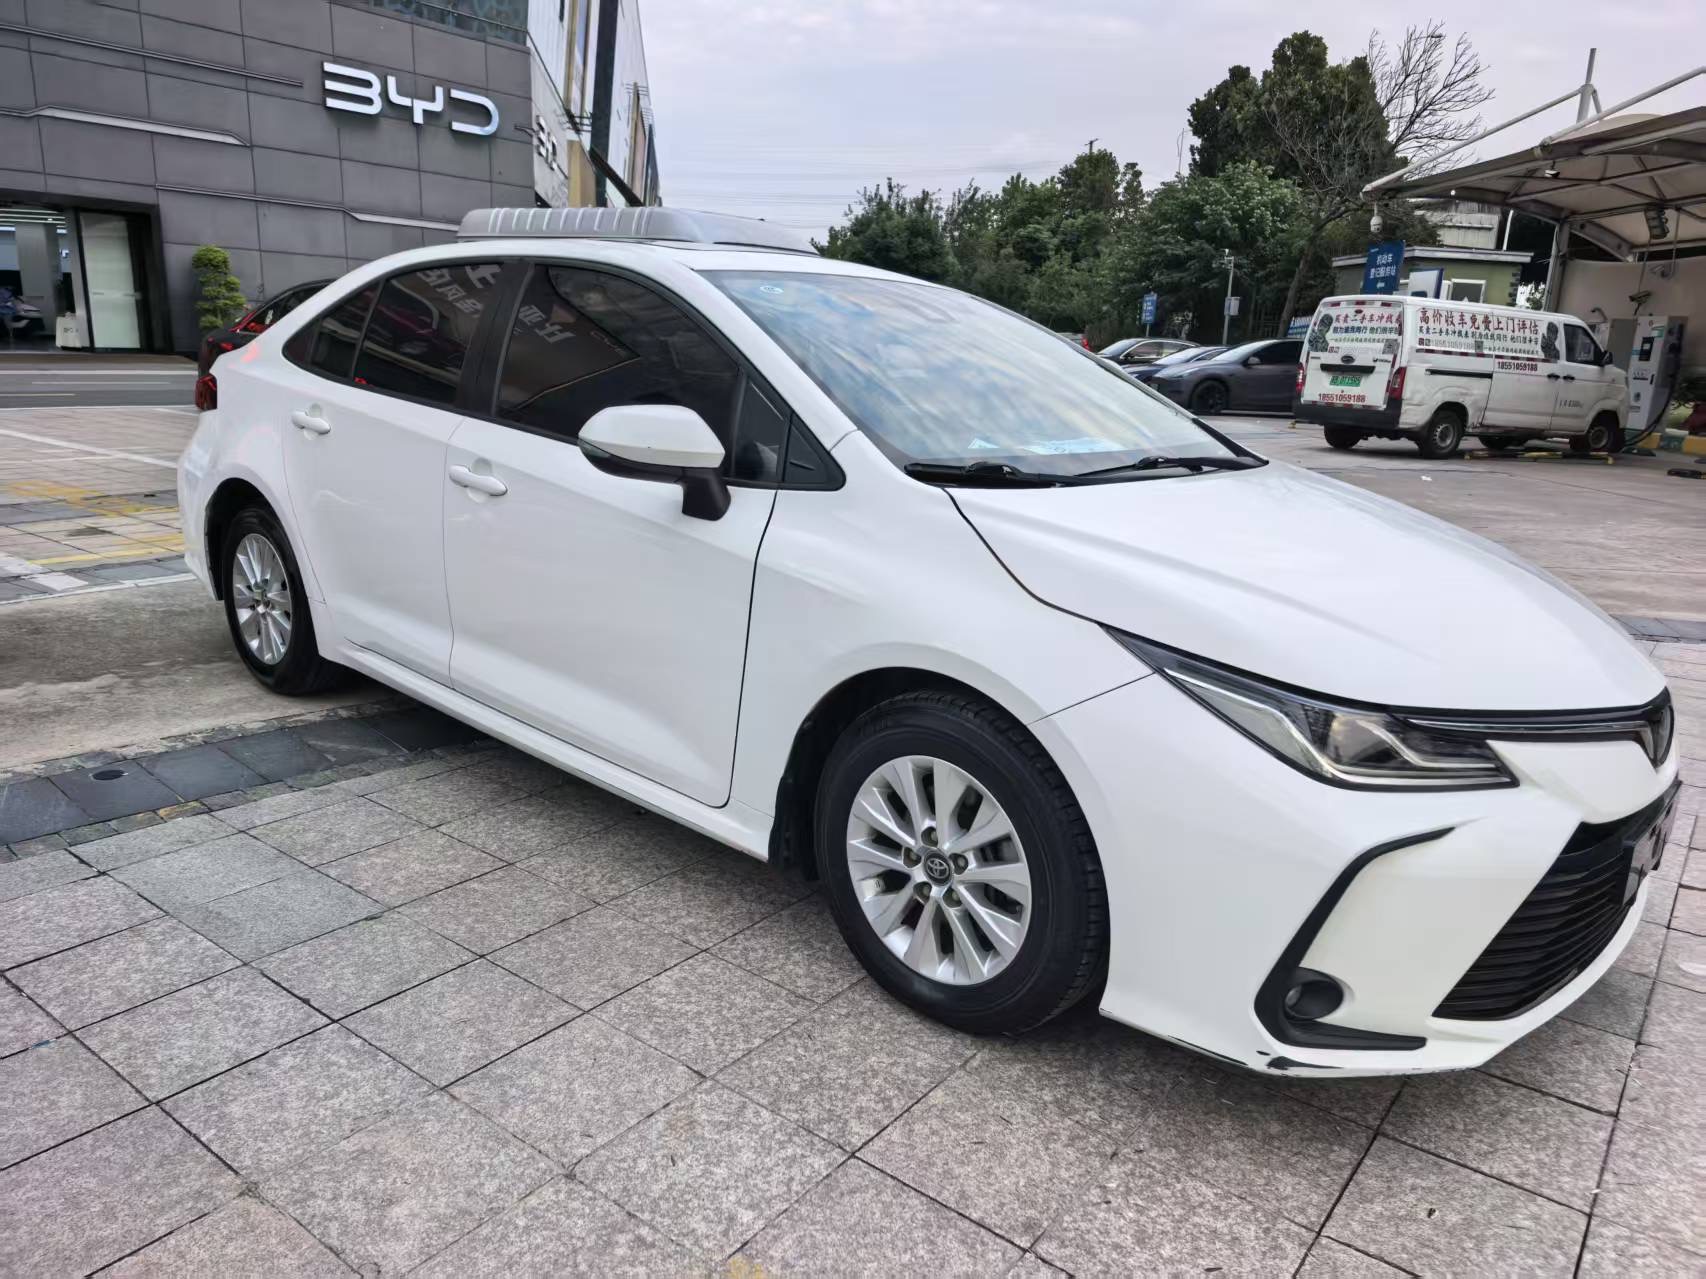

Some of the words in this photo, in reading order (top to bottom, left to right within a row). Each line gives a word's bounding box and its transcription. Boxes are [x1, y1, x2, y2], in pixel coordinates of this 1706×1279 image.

[323, 61, 500, 136] BYD
[1419, 307, 1539, 335] 高价收车免费上门评估
[1497, 361, 1538, 372] 18551059188
[1318, 393, 1366, 403] 18551059188
